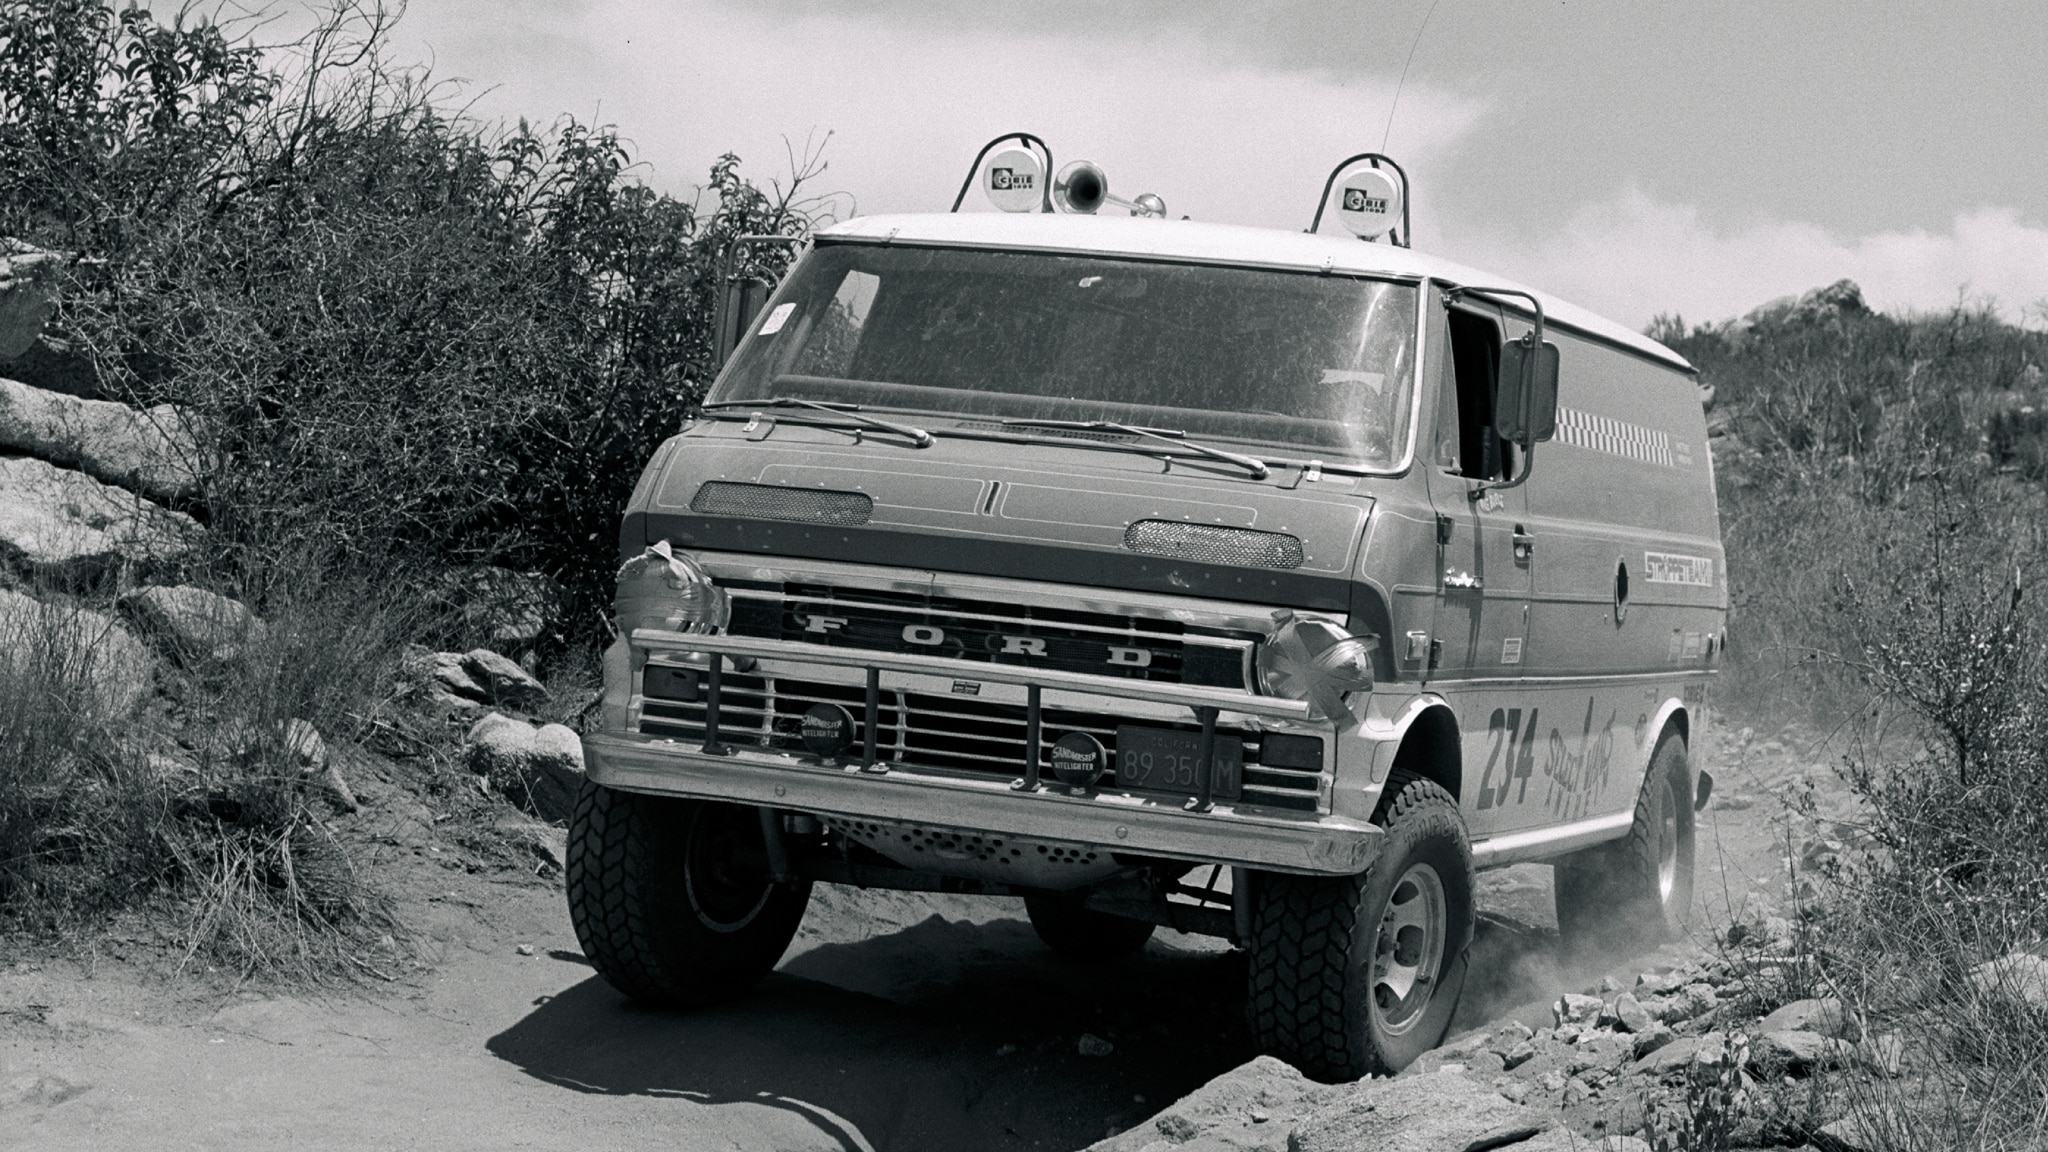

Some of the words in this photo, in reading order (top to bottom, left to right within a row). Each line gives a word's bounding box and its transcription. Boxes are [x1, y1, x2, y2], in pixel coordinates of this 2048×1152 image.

[803, 614, 1152, 668] FORD
[1052, 746, 1097, 762] SANDMASTER
[1151, 736, 1202, 751] CALIFORNI
[1054, 762, 1094, 771] NITELIGHTER
[1124, 749, 1154, 780] 89
[1476, 707, 1539, 811] 234
